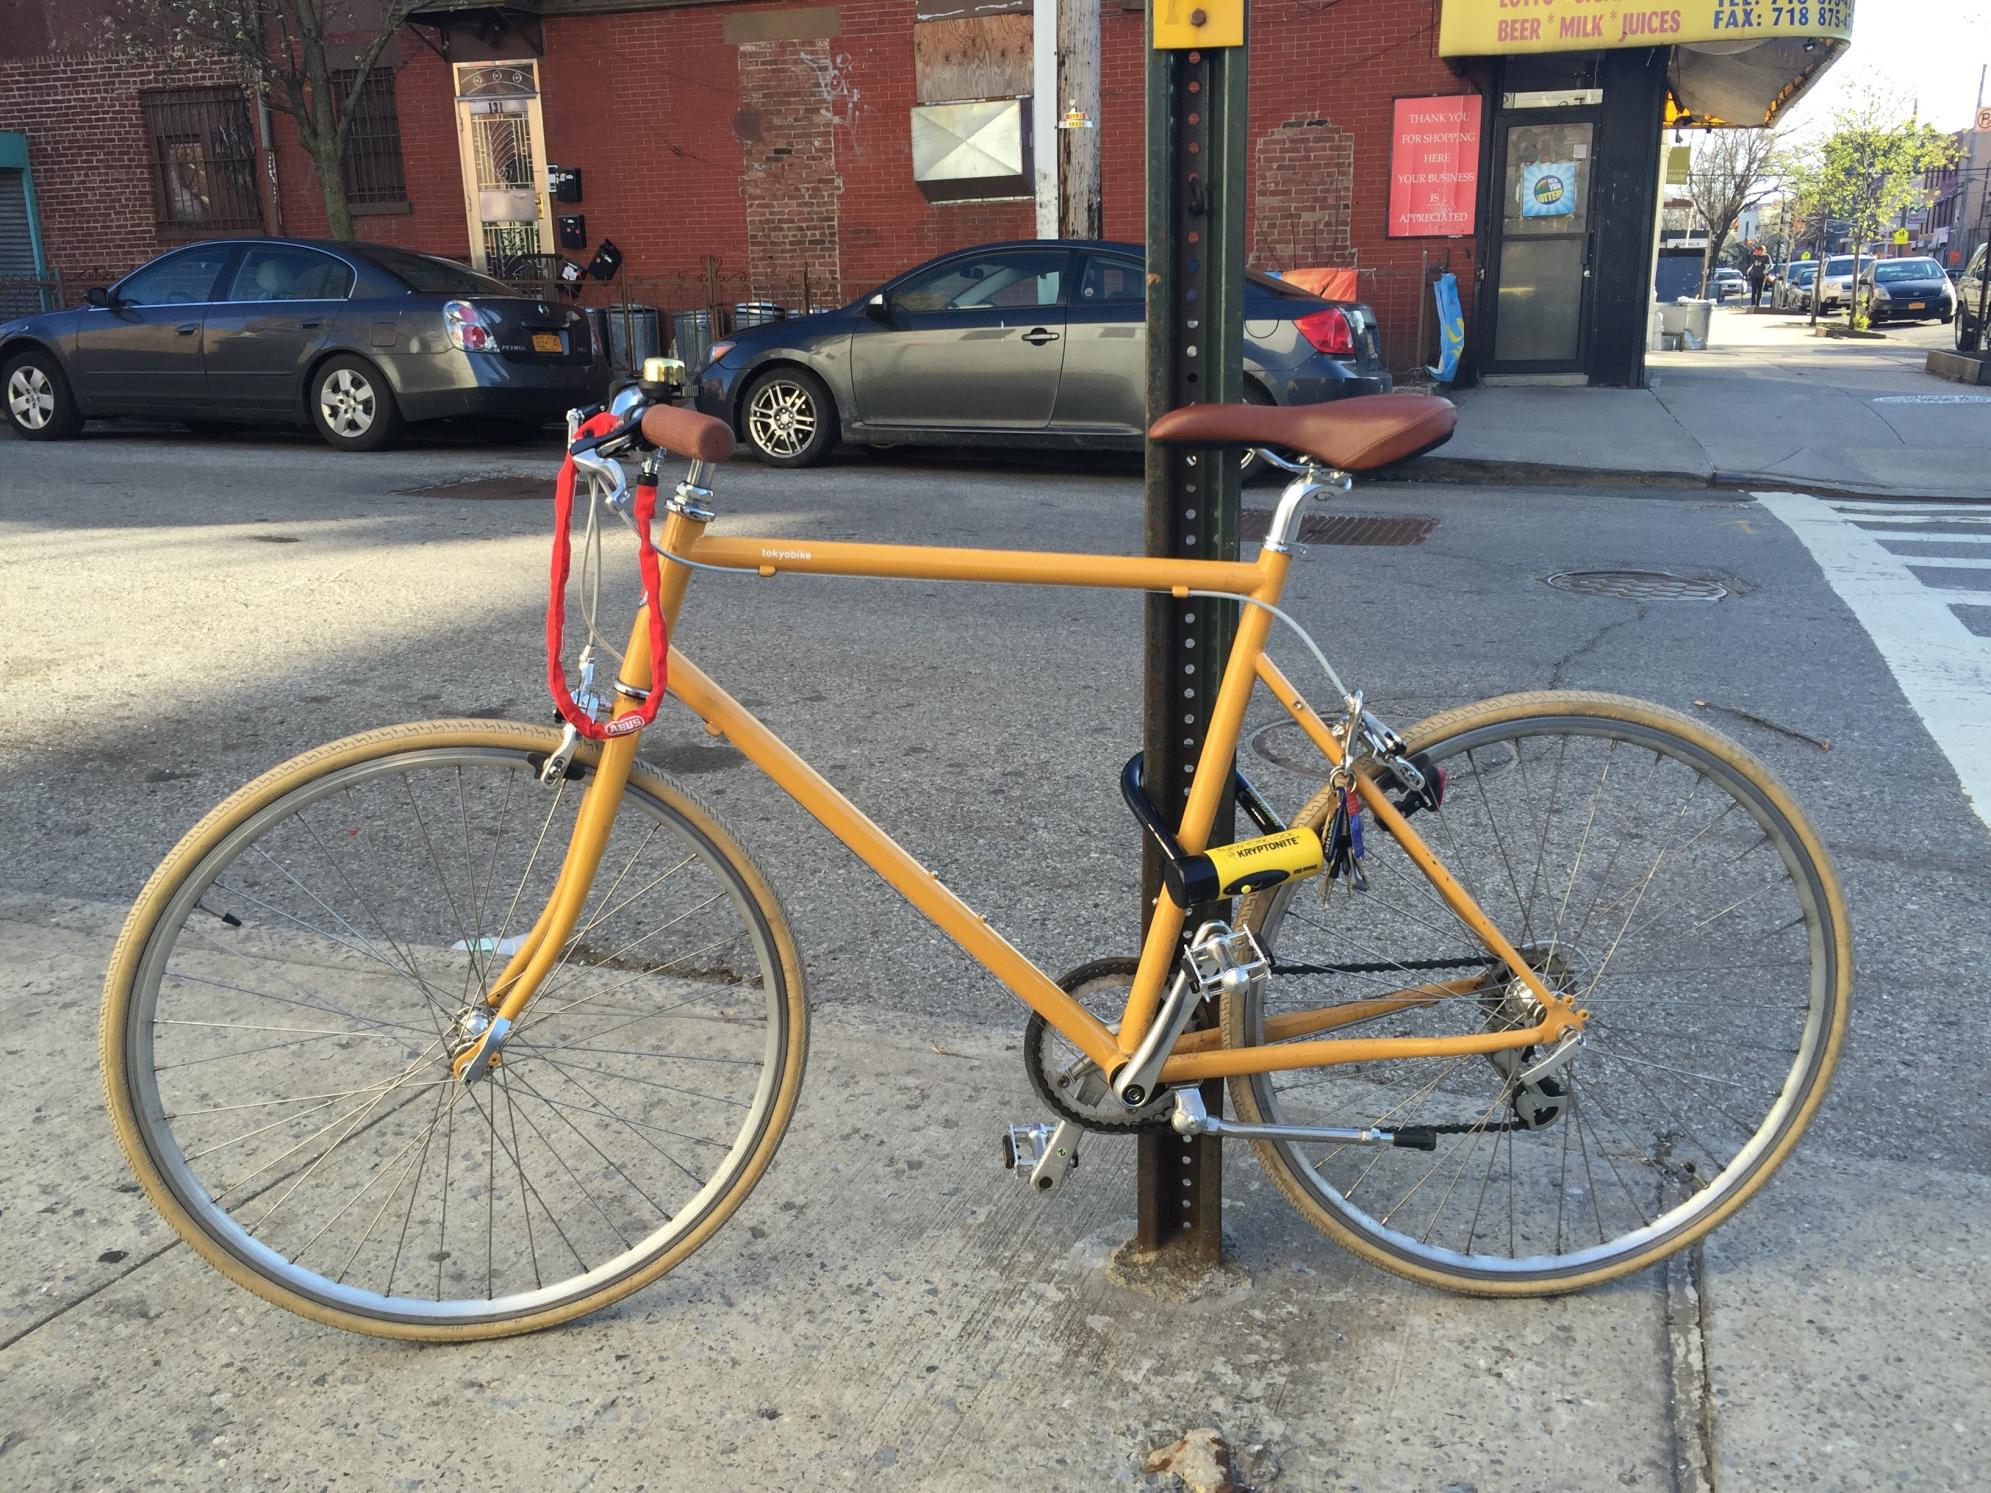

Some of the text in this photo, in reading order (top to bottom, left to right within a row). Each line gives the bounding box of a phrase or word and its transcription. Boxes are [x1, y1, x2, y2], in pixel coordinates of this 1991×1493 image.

[1713, 8, 1762, 29] FAX:
[1772, 7, 1809, 26] 718
[1497, 10, 1681, 42] BEER MILK JUICES
[488, 102, 504, 114] 131
[1408, 111, 1470, 124] THANK YOU
[1402, 132, 1476, 144] FOR SHOPPING
[1424, 153, 1451, 163] HERE
[1398, 172, 1475, 184] YOUR BUSINESS
[1430, 193, 1440, 203] IS
[1399, 212, 1468, 223] APPRECIATED
[761, 548, 812, 560] tokyobike
[610, 718, 642, 734] ABUS
[1237, 836, 1299, 858] KRYPTONITE
